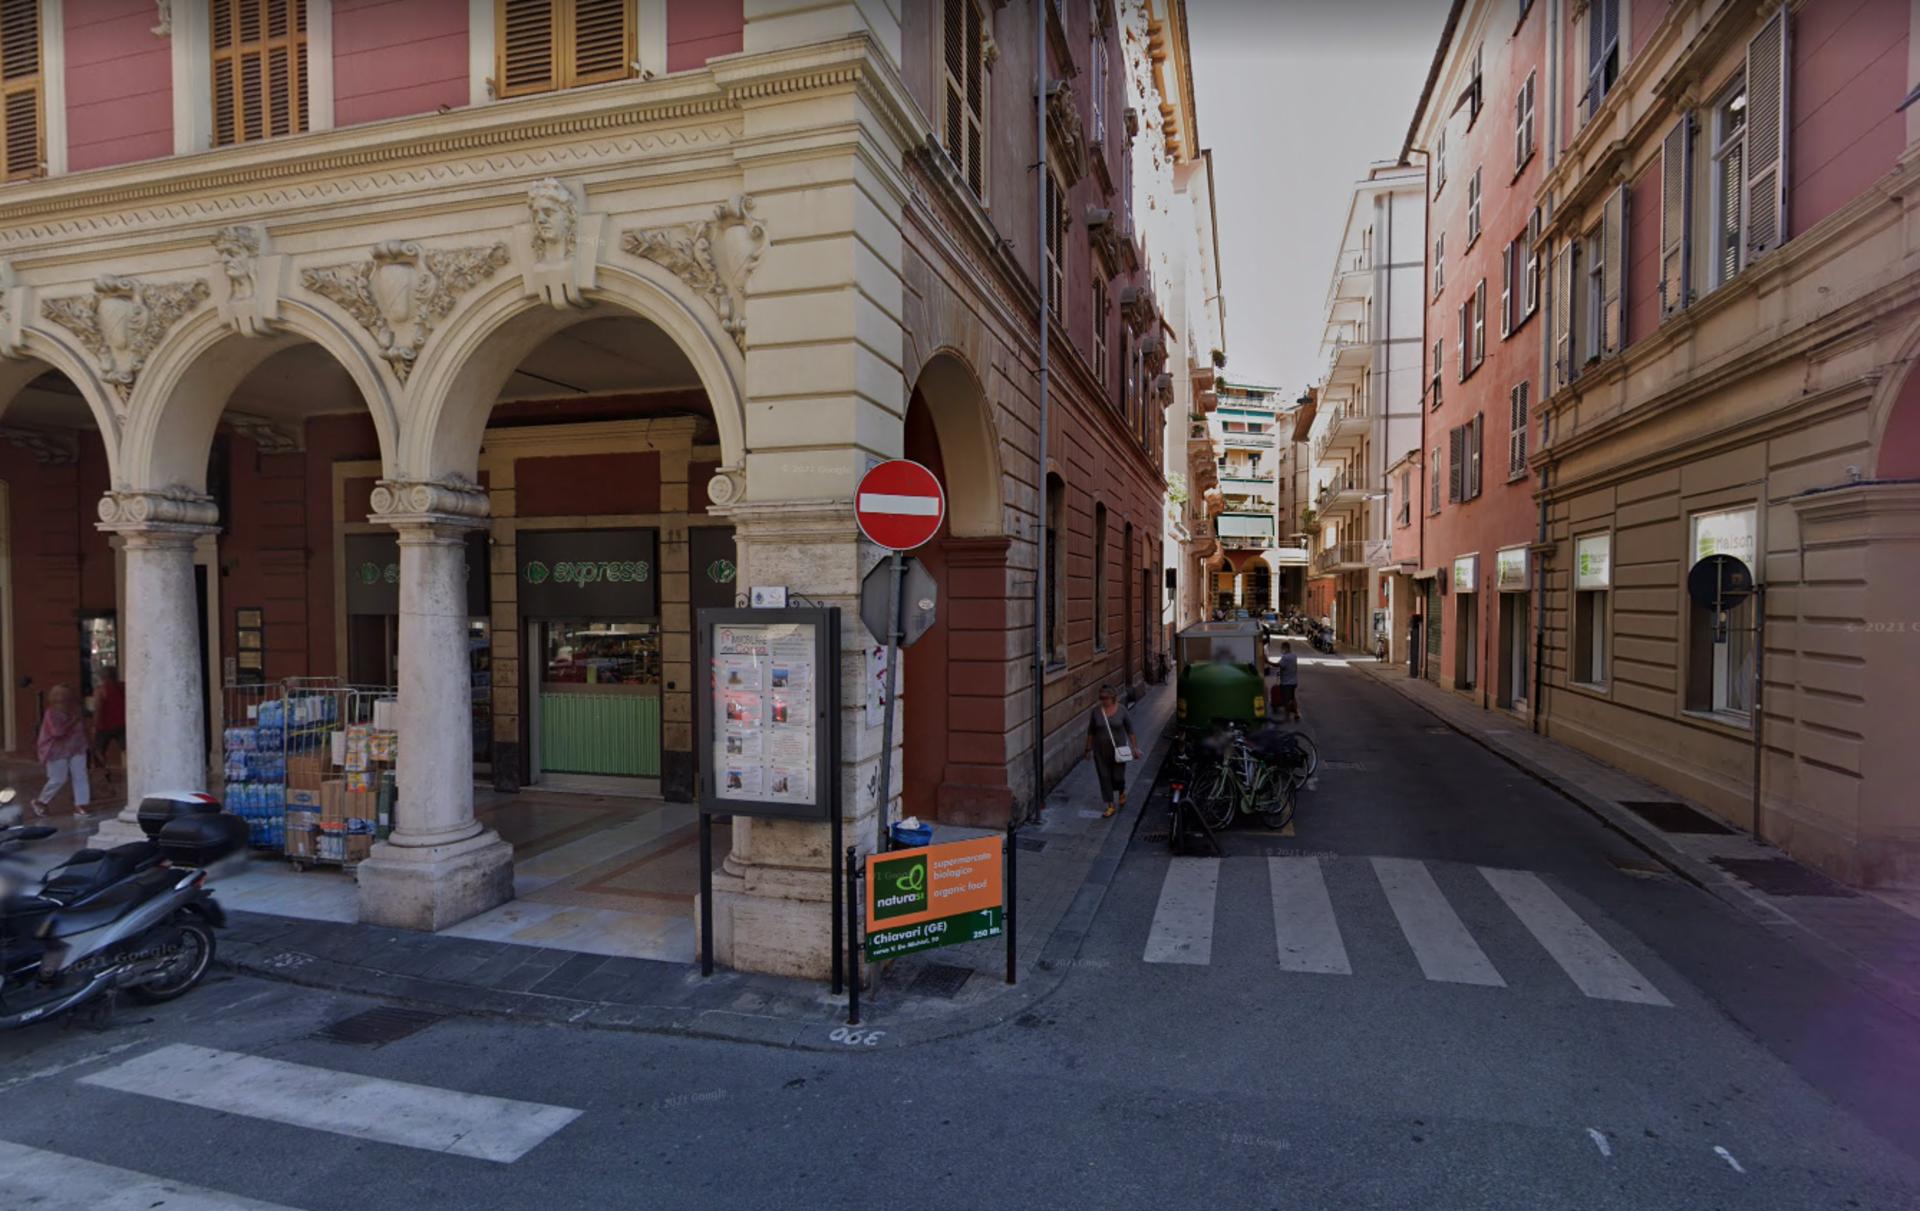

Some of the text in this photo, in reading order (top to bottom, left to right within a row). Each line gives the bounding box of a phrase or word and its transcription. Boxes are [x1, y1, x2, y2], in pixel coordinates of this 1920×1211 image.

[553, 561, 649, 588] express
[967, 879, 988, 891] food
[873, 921, 948, 945] Chiavari (GE)
